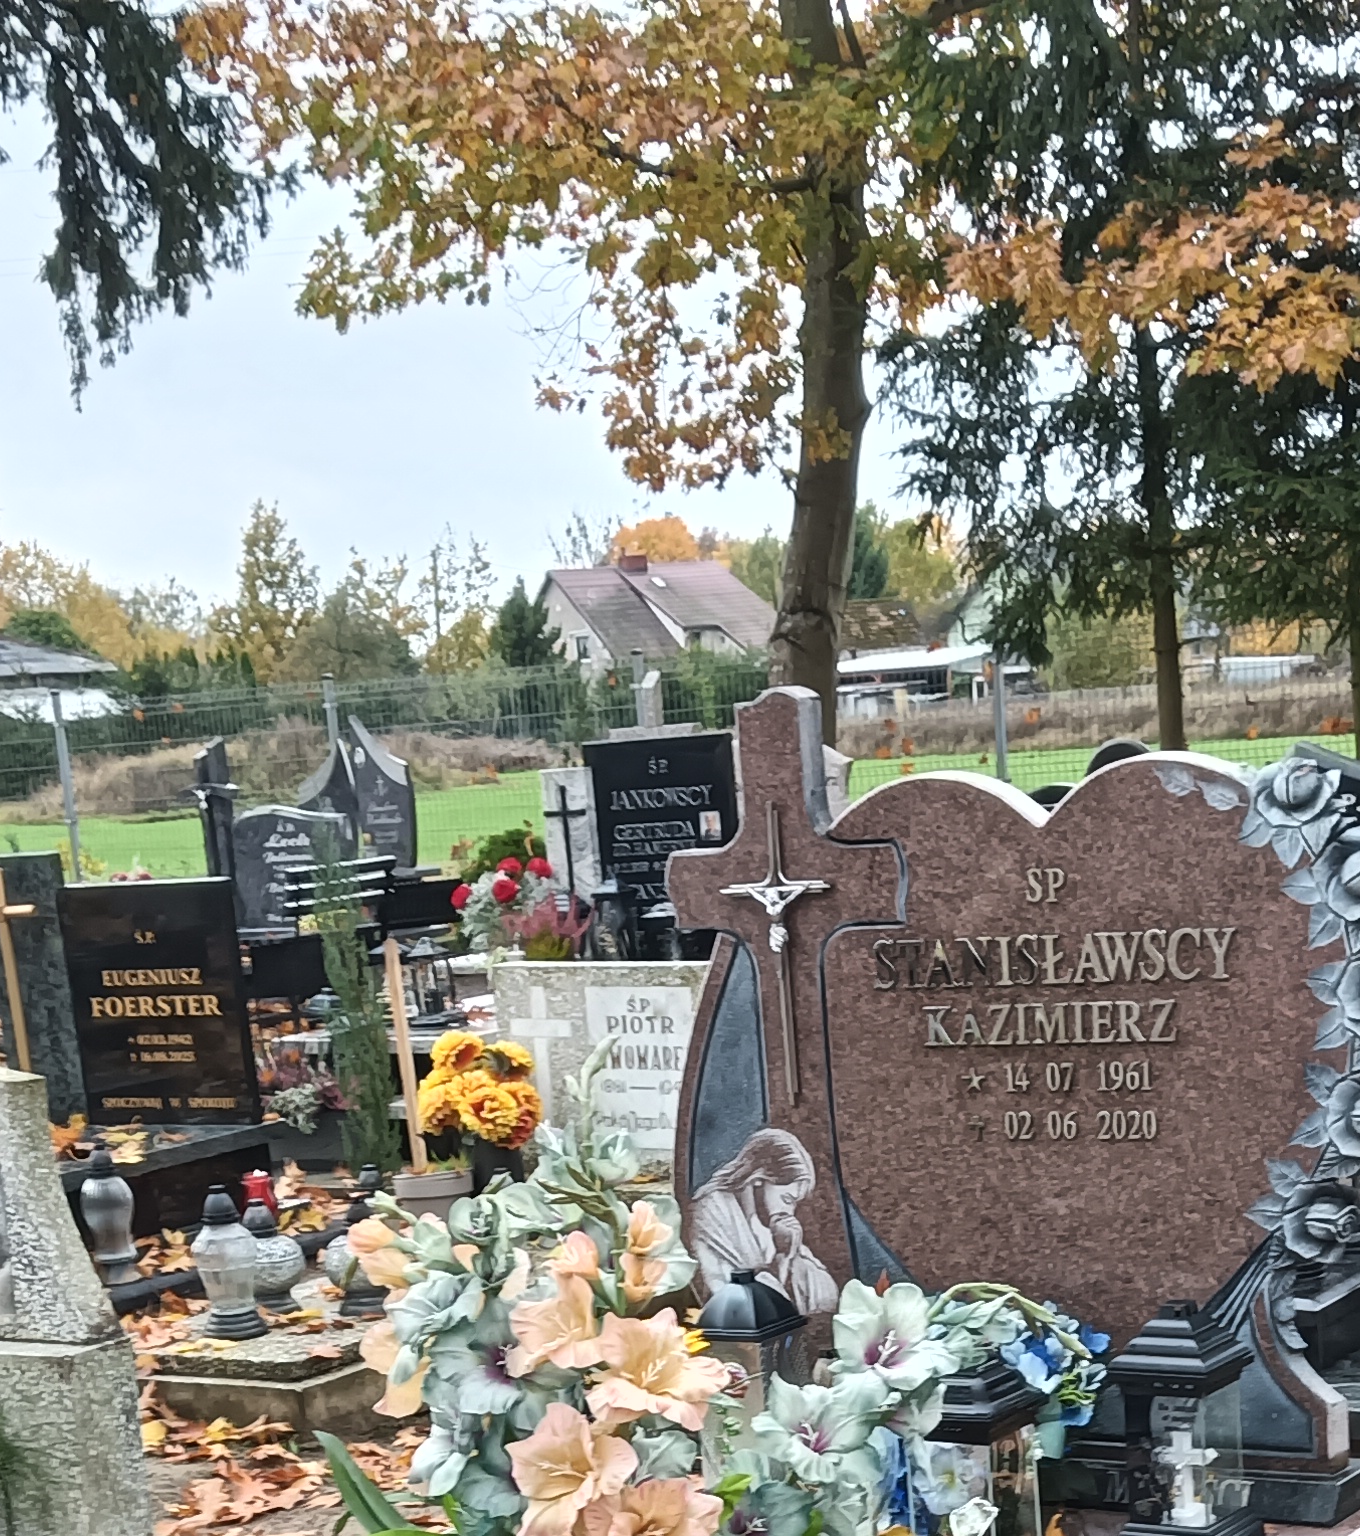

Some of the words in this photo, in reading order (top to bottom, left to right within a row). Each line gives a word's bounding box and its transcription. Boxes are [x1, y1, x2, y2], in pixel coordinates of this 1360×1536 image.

[872, 926, 1236, 990] STANISŁAWSCY
[101, 967, 204, 987] EUGENIUSZ
[90, 994, 224, 1018] FOERSTER
[606, 1015, 674, 1034] PIOTR
[922, 999, 1178, 1048] KAZIMIERZ
[1003, 1062, 1031, 1093] 14
[1045, 1062, 1075, 1093] 07
[1097, 1060, 1154, 1093] 1961
[1003, 1111, 1034, 1141] 02
[1047, 1110, 1078, 1141] 06
[1096, 1109, 1158, 1141] 2020
